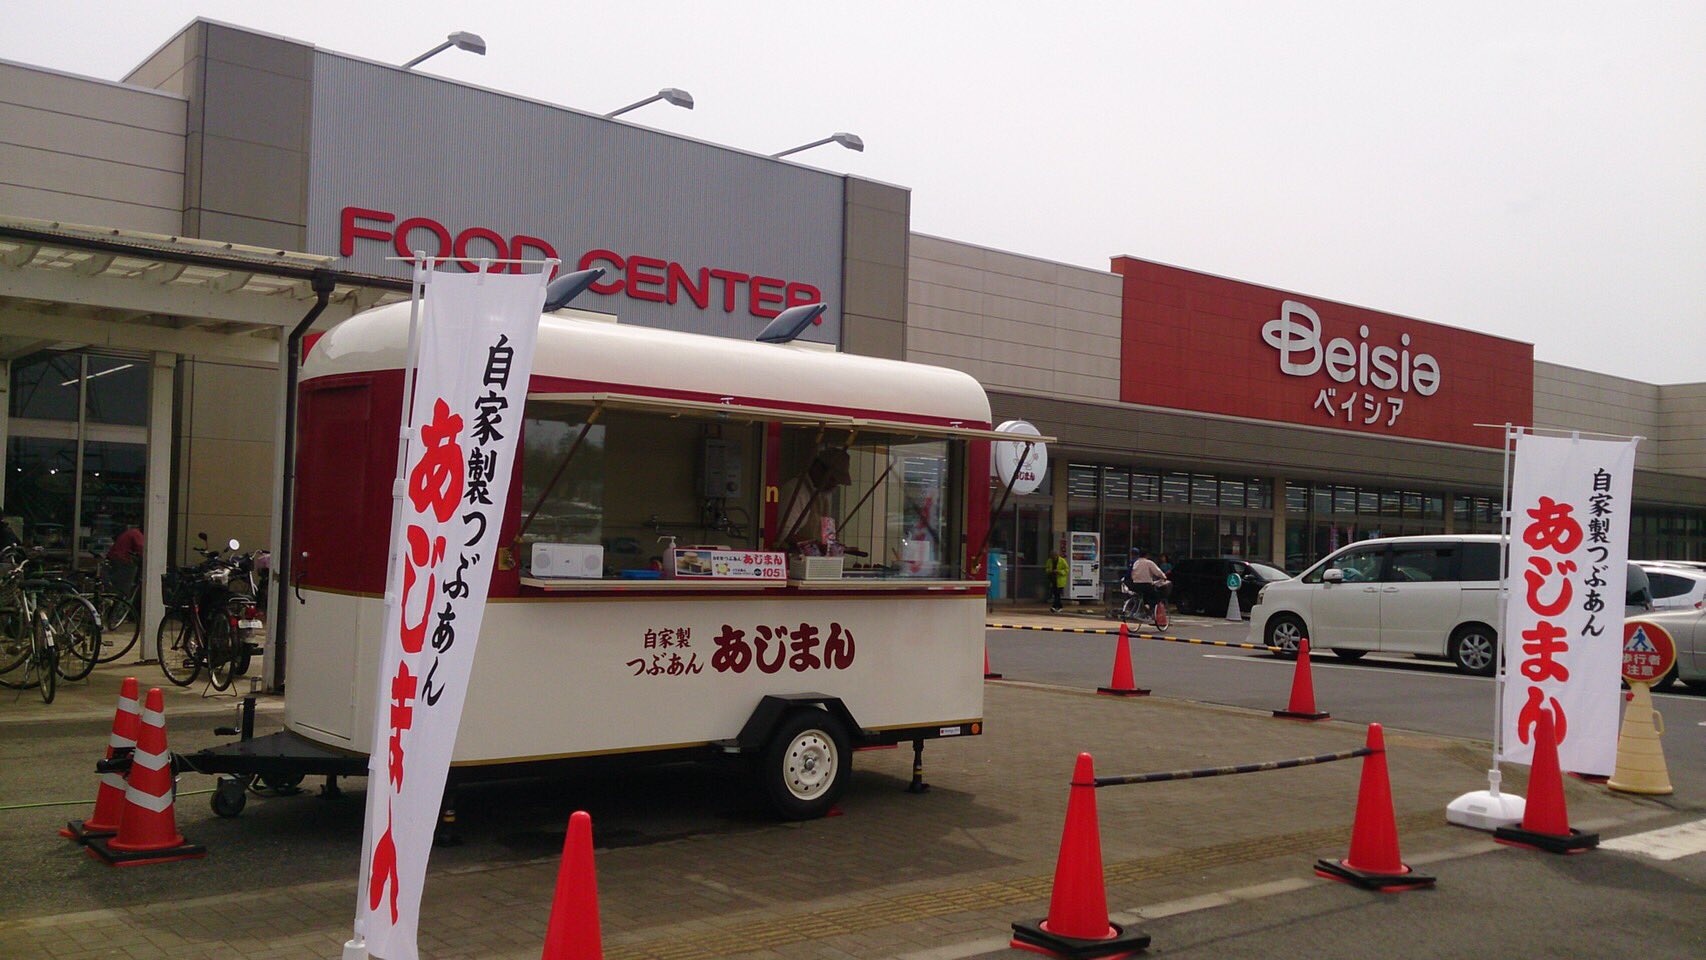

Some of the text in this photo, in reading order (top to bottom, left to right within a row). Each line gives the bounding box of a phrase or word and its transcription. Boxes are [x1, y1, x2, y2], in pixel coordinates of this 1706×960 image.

[340, 206, 822, 326] FOOD CENTER
[1262, 300, 1441, 396] Beisia
[1314, 388, 1404, 426] ベイシア
[421, 333, 513, 706] 自家製つぶあん
[743, 554, 783, 565] あじまん
[763, 568, 780, 577] 105
[1581, 468, 1613, 638] 自家製つぶあん
[644, 627, 692, 650] 自家製
[1517, 496, 1584, 746] あじまん
[626, 652, 705, 677] つぶあん
[711, 622, 856, 675] あじまん
